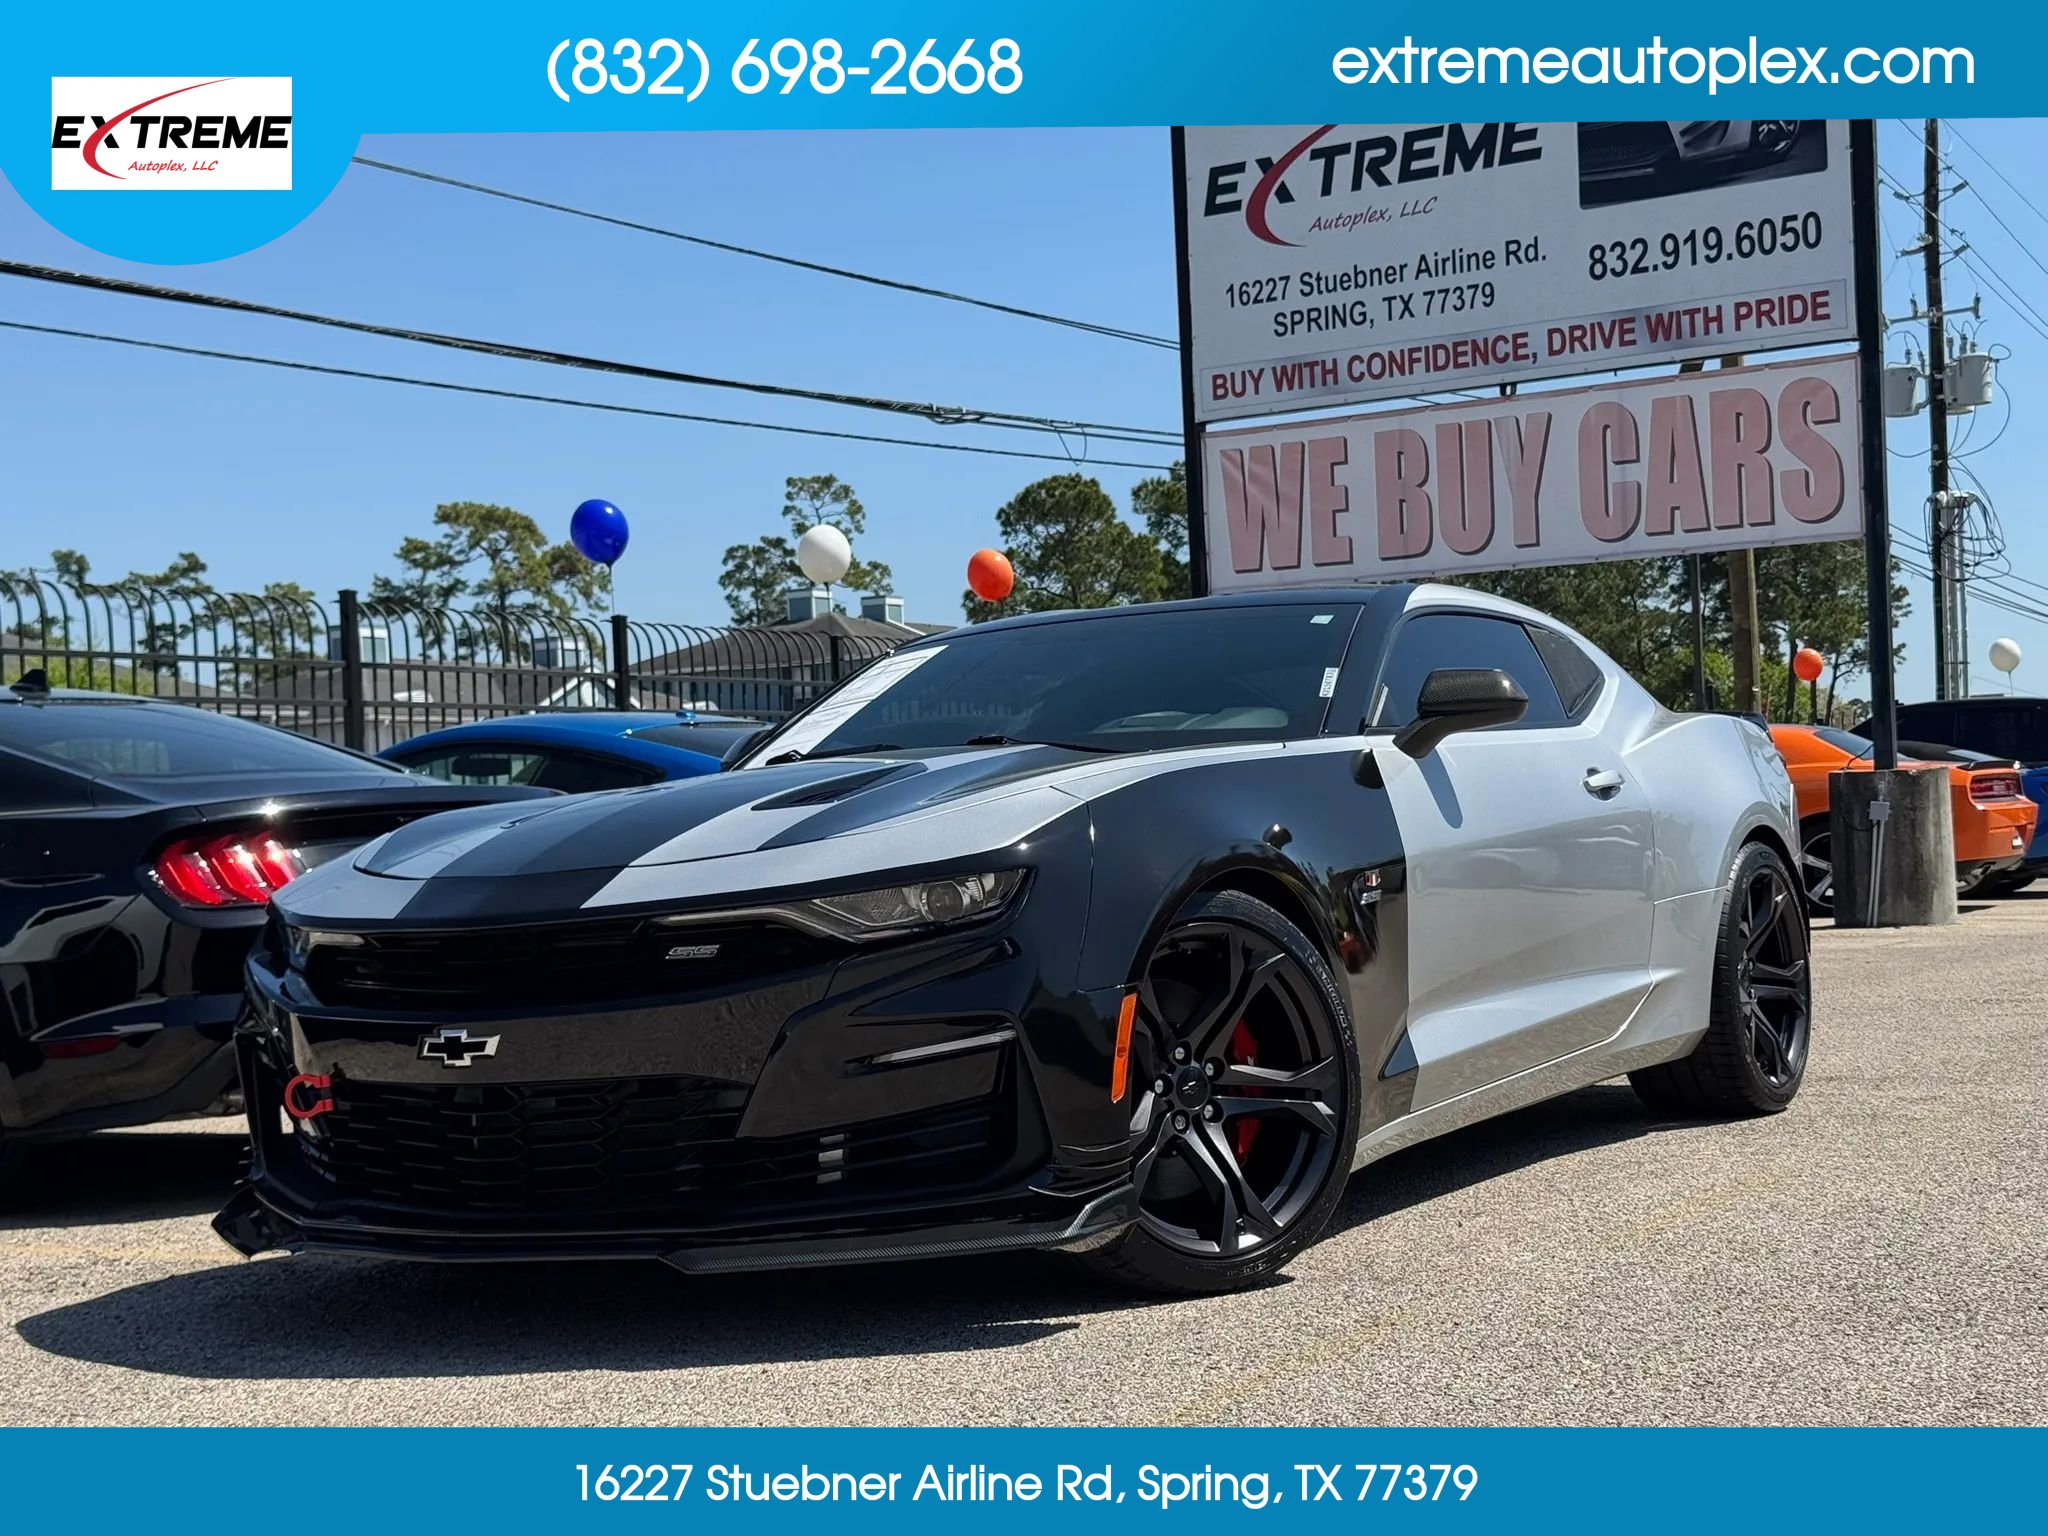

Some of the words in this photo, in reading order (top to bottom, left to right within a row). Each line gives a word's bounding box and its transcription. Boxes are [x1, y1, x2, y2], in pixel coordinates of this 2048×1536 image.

[1203, 121, 1544, 218] EXTREME
[1308, 204, 1393, 233] Autoplex,
[1399, 196, 1439, 218] LLC
[1588, 211, 1823, 281] 832.919.6050
[1225, 275, 1292, 308] 16227
[1299, 261, 1410, 298] Stuebner
[1413, 246, 1497, 281] Airline
[1504, 235, 1548, 267] Rd.
[1211, 367, 1266, 401] BUY
[1271, 358, 1340, 394] WITH
[1346, 331, 1539, 383] CONFIDENCE,
[1547, 316, 1638, 357] DRIVE
[1644, 304, 1723, 344] WITH
[1733, 289, 1831, 332] PRIDE
[1273, 300, 1376, 338] SPRING,
[1382, 293, 1416, 322] TX
[1423, 281, 1497, 316] 77379
[1219, 435, 1353, 574] WE
[1373, 410, 1553, 561] BUY
[1577, 376, 1845, 543] CARS
[665, 944, 721, 960] SS
